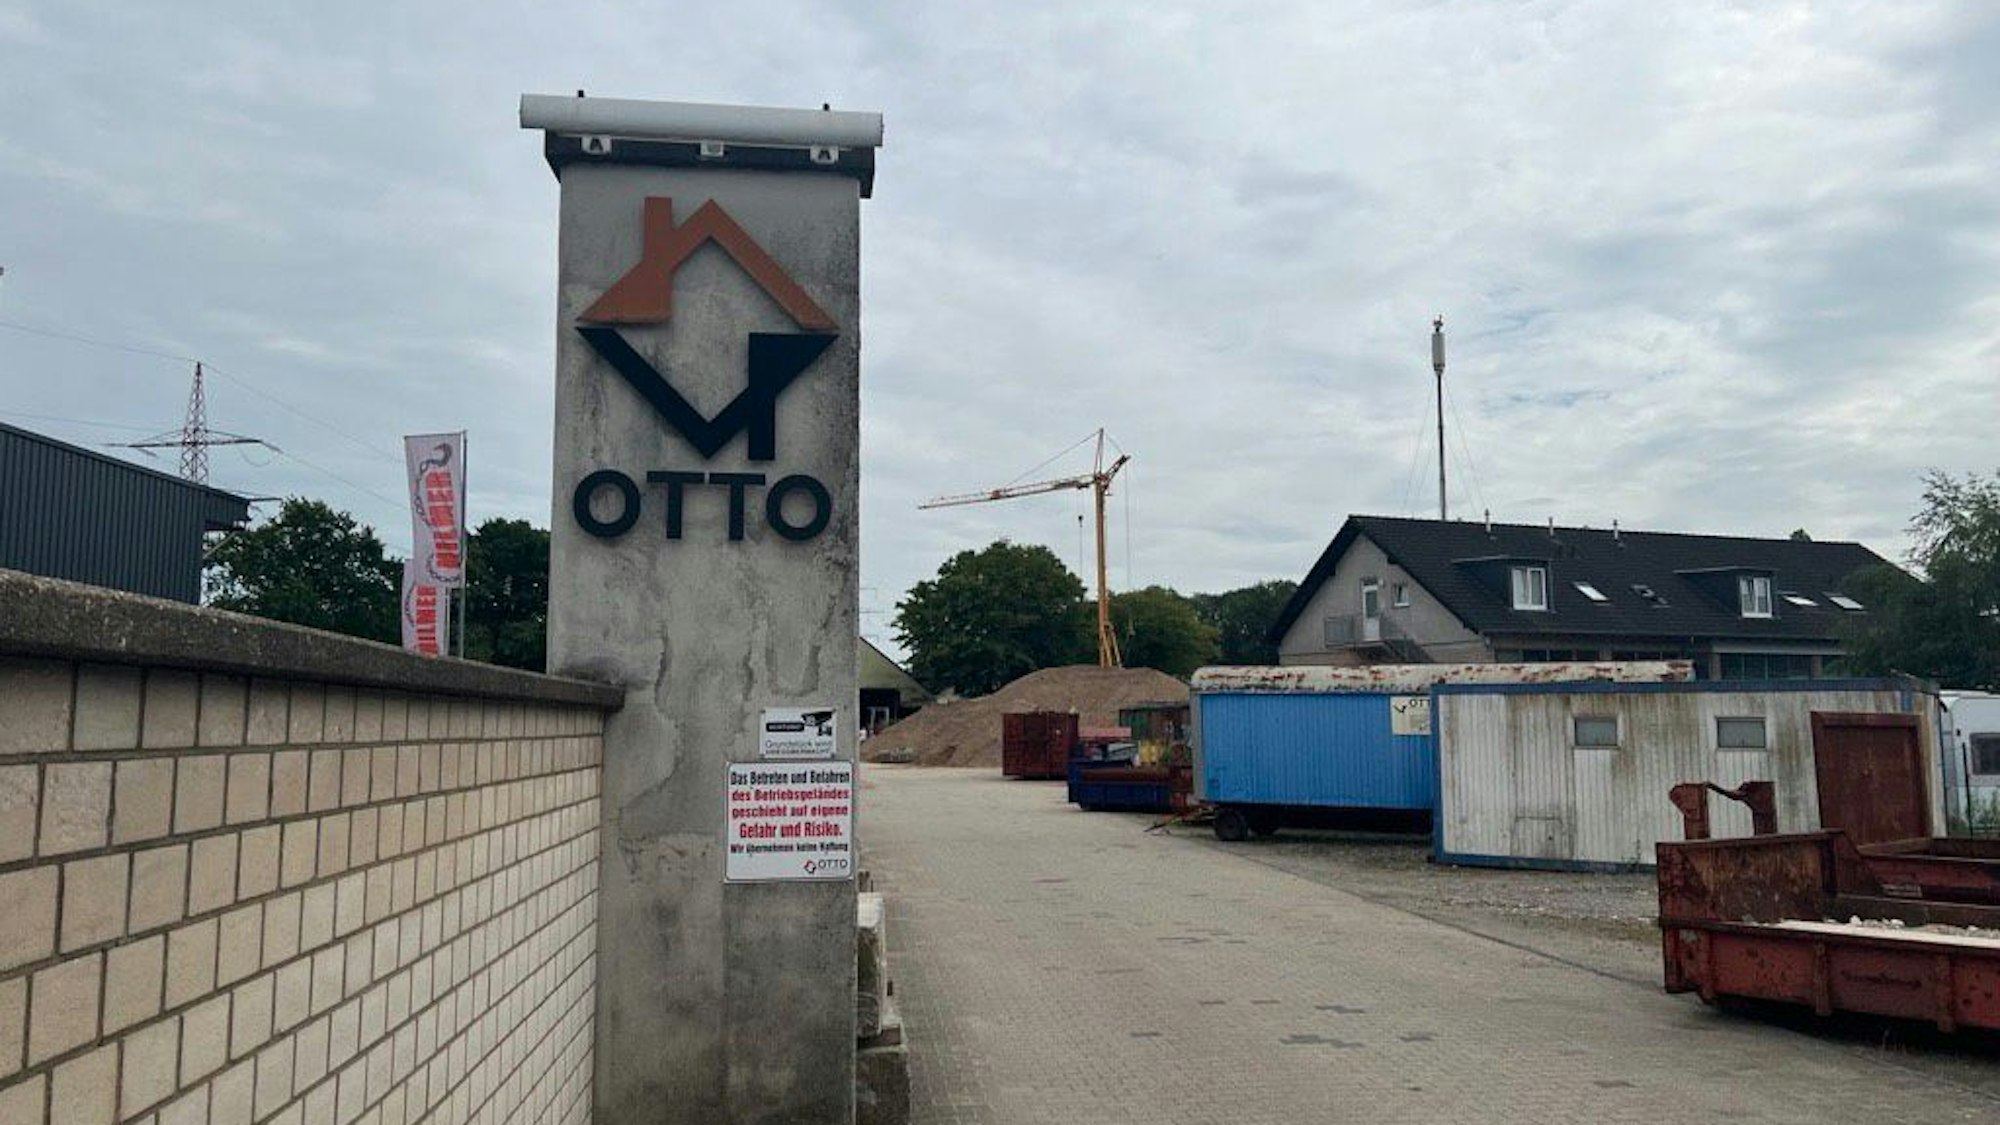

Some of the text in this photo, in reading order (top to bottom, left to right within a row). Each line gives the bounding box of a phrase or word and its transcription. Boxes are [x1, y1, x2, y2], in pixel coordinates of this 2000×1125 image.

[573, 469, 832, 541] OTTO
[731, 769, 850, 785] Das Betreten und Befahren
[732, 788, 849, 802] des Betriebsgeländes
[732, 804, 848, 819] geschieht auf eigene
[740, 821, 843, 838] Gefahr und Risiko.
[730, 844, 744, 853] Wir
[747, 843, 794, 853] übernehmen
[797, 842, 817, 852] keine
[818, 859, 848, 869] OTTO
